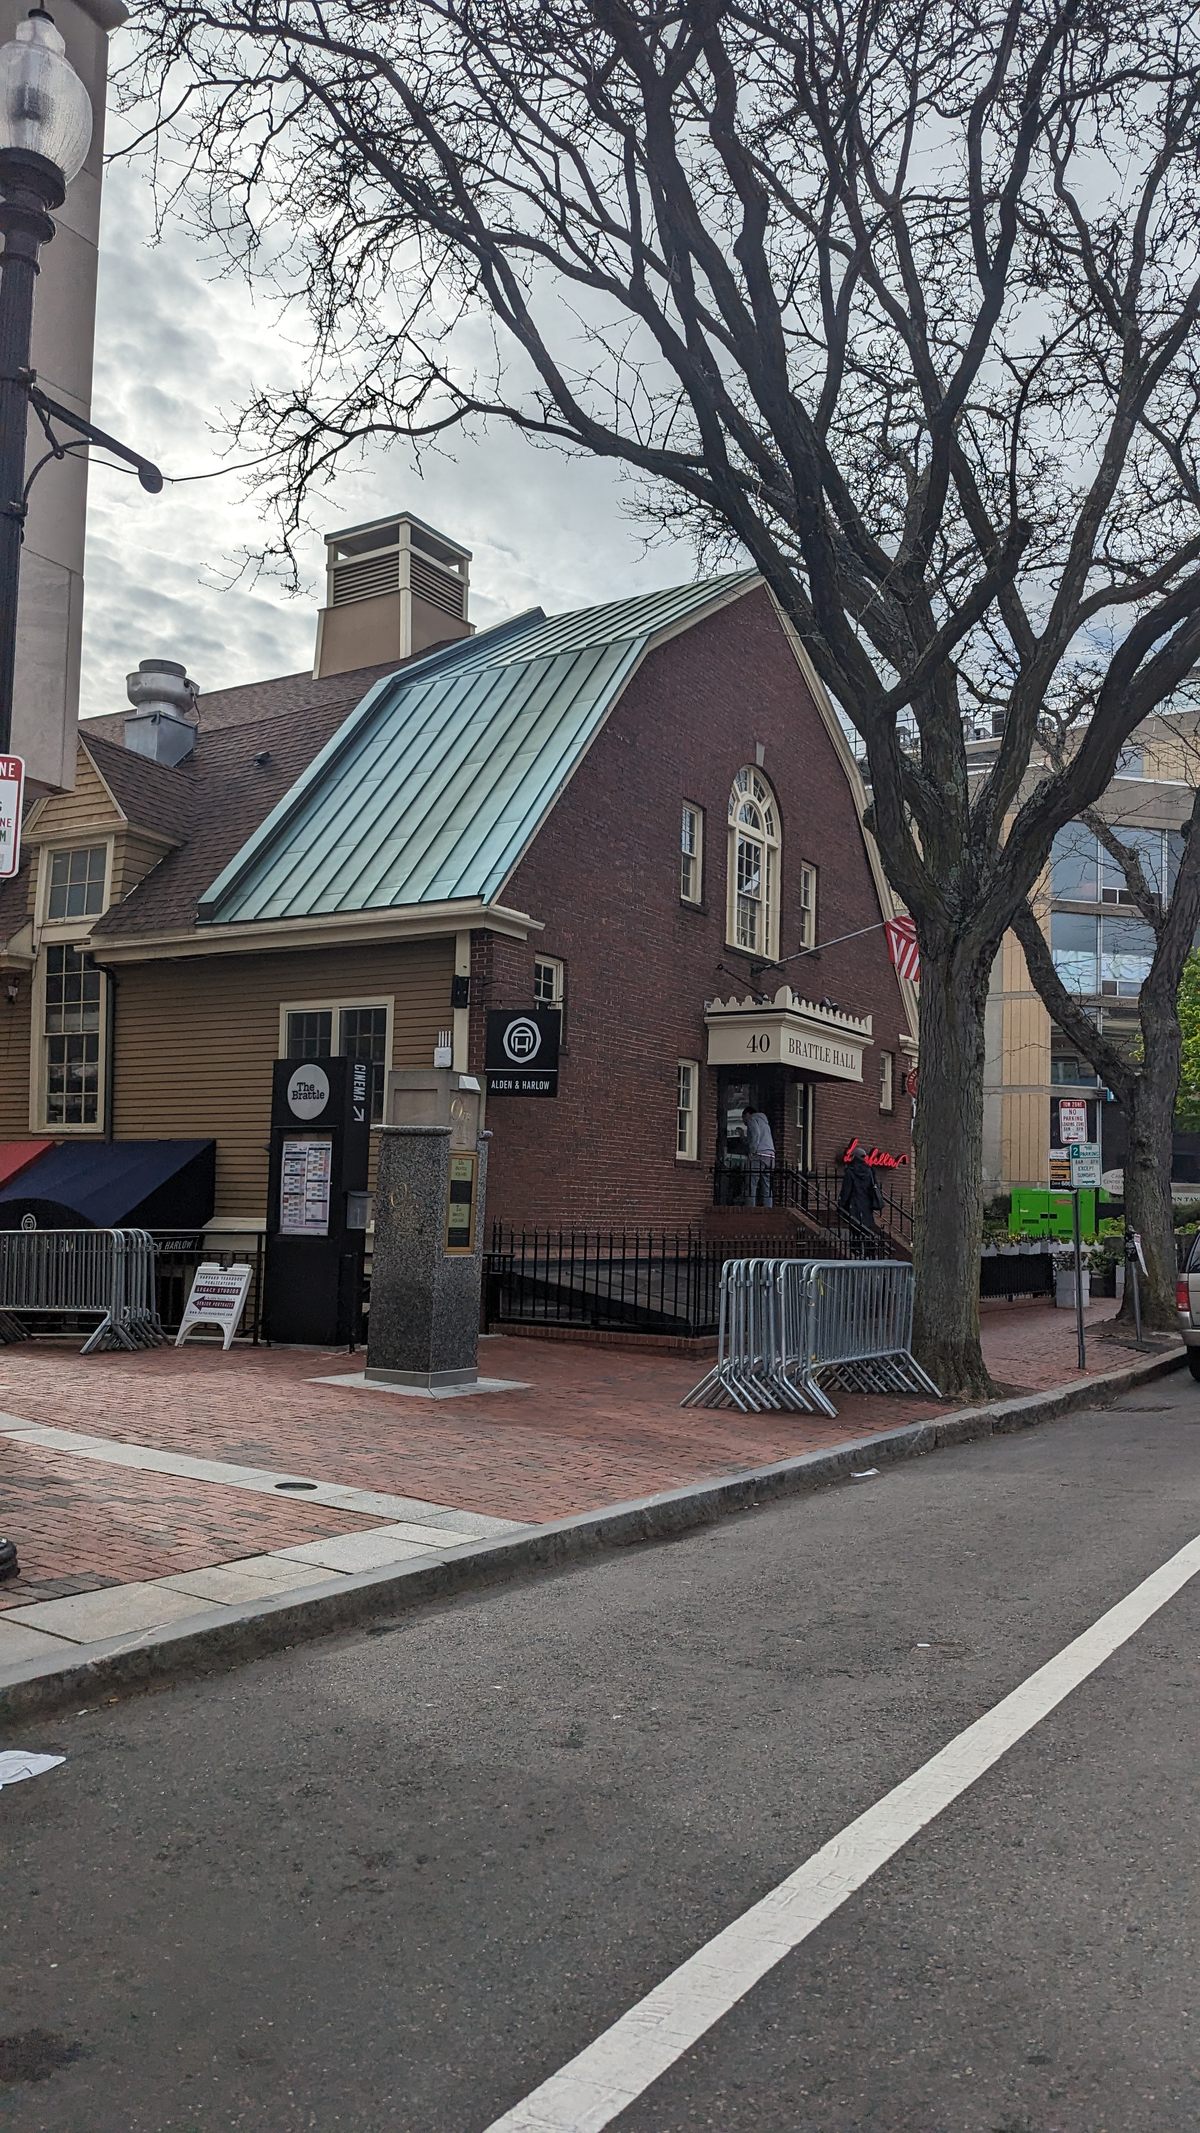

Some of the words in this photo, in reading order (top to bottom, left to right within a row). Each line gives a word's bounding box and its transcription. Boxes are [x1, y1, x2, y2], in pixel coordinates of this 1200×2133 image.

[746, 1033, 771, 1053] 40
[788, 1037, 831, 1063] BRATTLE
[833, 1049, 856, 1070] HALL
[297, 1082, 315, 1092] The
[353, 1064, 366, 1101] CINEMA
[491, 1080, 513, 1090] ALDEN
[514, 1080, 520, 1090] &
[522, 1080, 550, 1090] HARLOW
[291, 1090, 325, 1100] Brattle
[1072, 1147, 1079, 1156] 2
[164, 1240, 193, 1250] HARLOW
